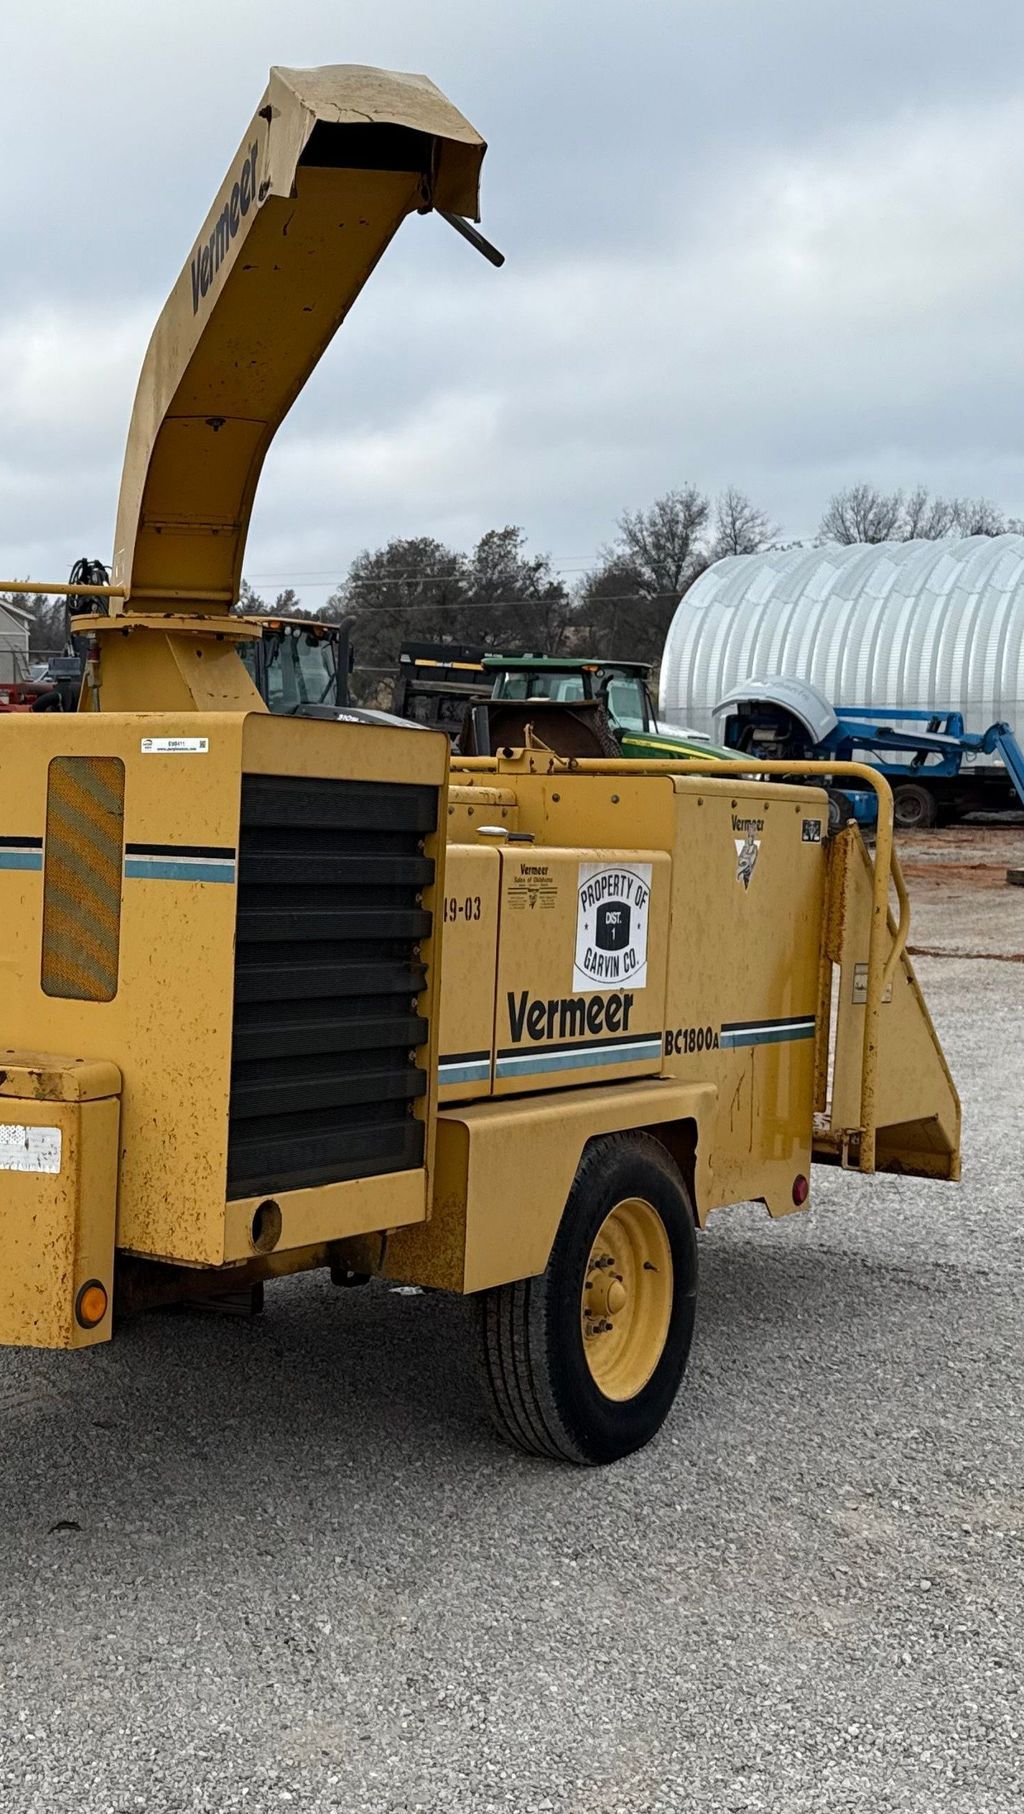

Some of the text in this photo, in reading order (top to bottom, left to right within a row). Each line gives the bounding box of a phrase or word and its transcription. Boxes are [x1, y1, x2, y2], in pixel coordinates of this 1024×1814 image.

[191, 139, 259, 317] Vermeer
[731, 814, 765, 831] Vermeer
[520, 863, 549, 876] Vermeer
[580, 874, 634, 912] PROPERTY
[634, 885, 648, 909] OF
[605, 911, 623, 925] DIST.
[610, 927, 617, 941] 1
[584, 947, 640, 978] GARVIN CO.
[507, 991, 634, 1043] Vermeer
[664, 1026, 720, 1057] BC1800A
